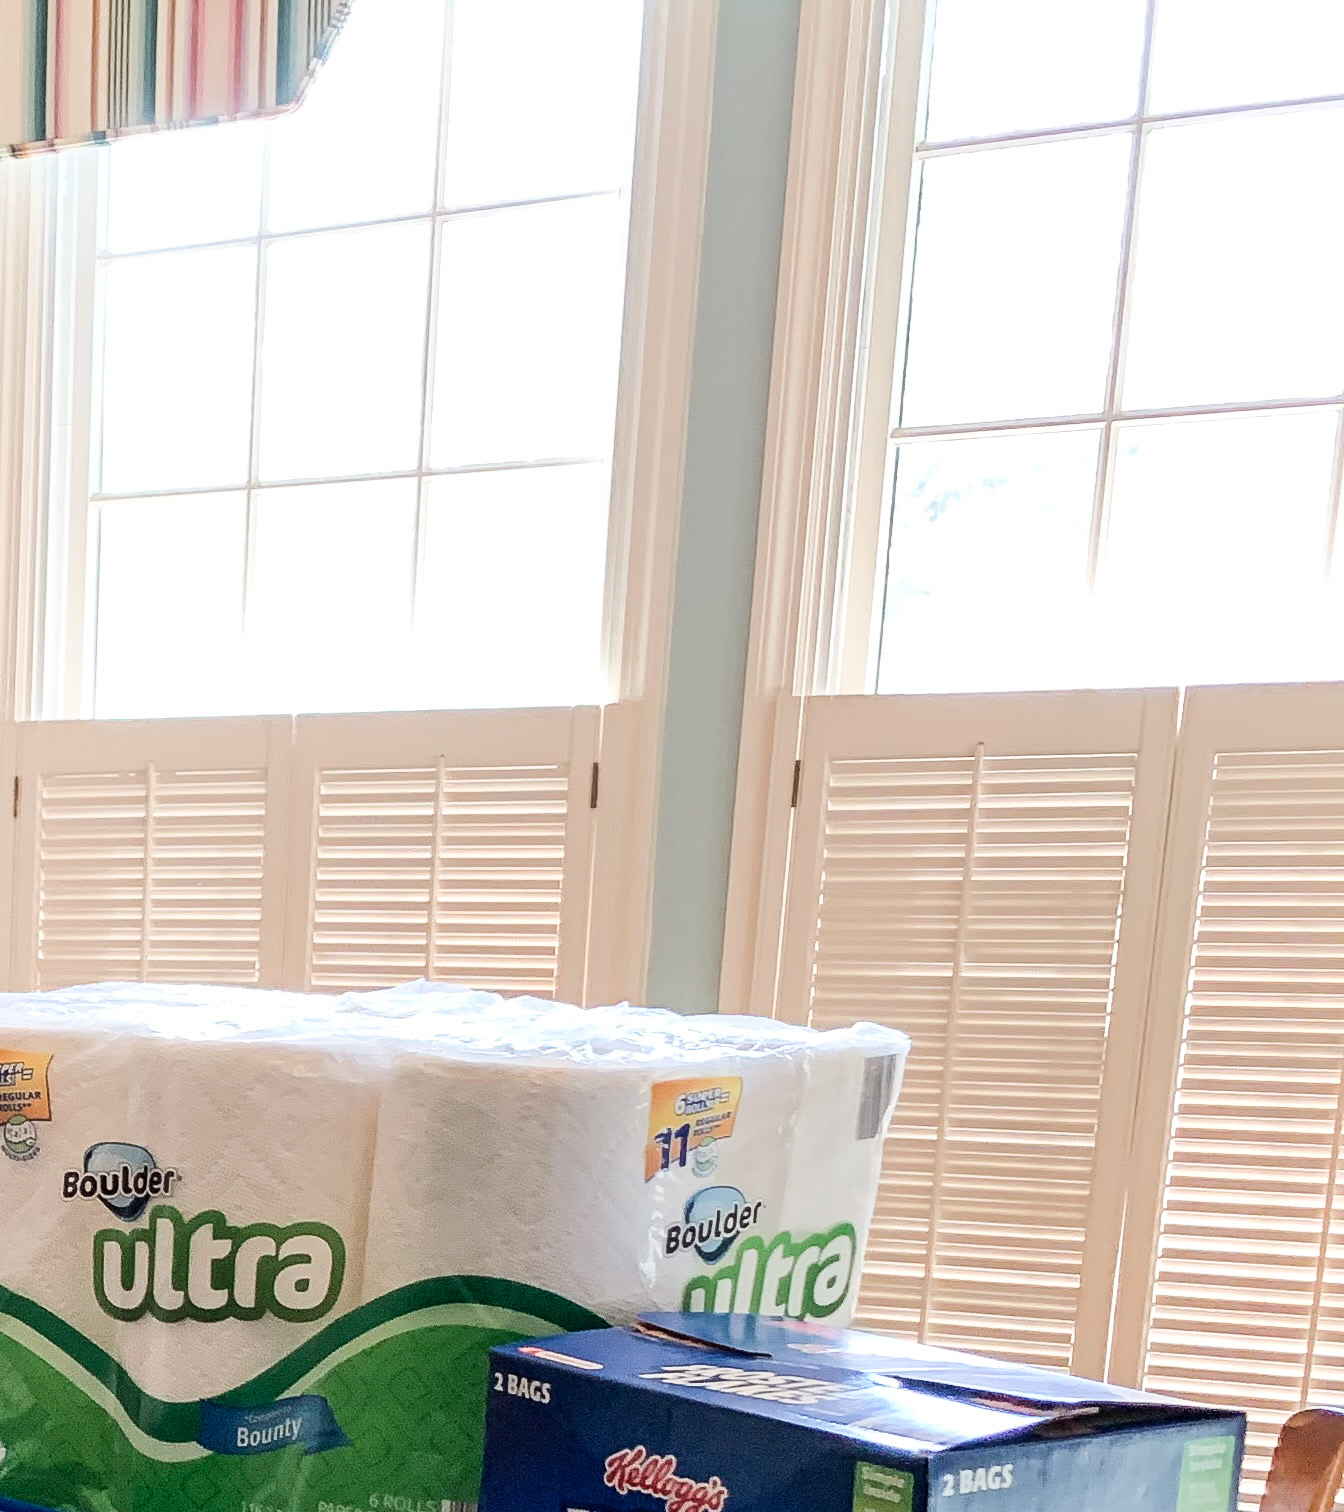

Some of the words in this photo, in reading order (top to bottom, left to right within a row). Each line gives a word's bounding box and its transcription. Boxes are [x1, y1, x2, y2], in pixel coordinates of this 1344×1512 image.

[654, 1123, 691, 1170] 11
[62, 1165, 175, 1200] Boulder
[665, 1200, 763, 1256] Boulder
[99, 1212, 337, 1314] ultra
[688, 1232, 855, 1318] ultra
[493, 1371, 504, 1393] 2
[507, 1373, 553, 1405] BAGS
[236, 1416, 304, 1448] Bounty
[942, 1472, 955, 1498] 2
[959, 1463, 1014, 1495] BAGS
[368, 1493, 380, 1508] 6
